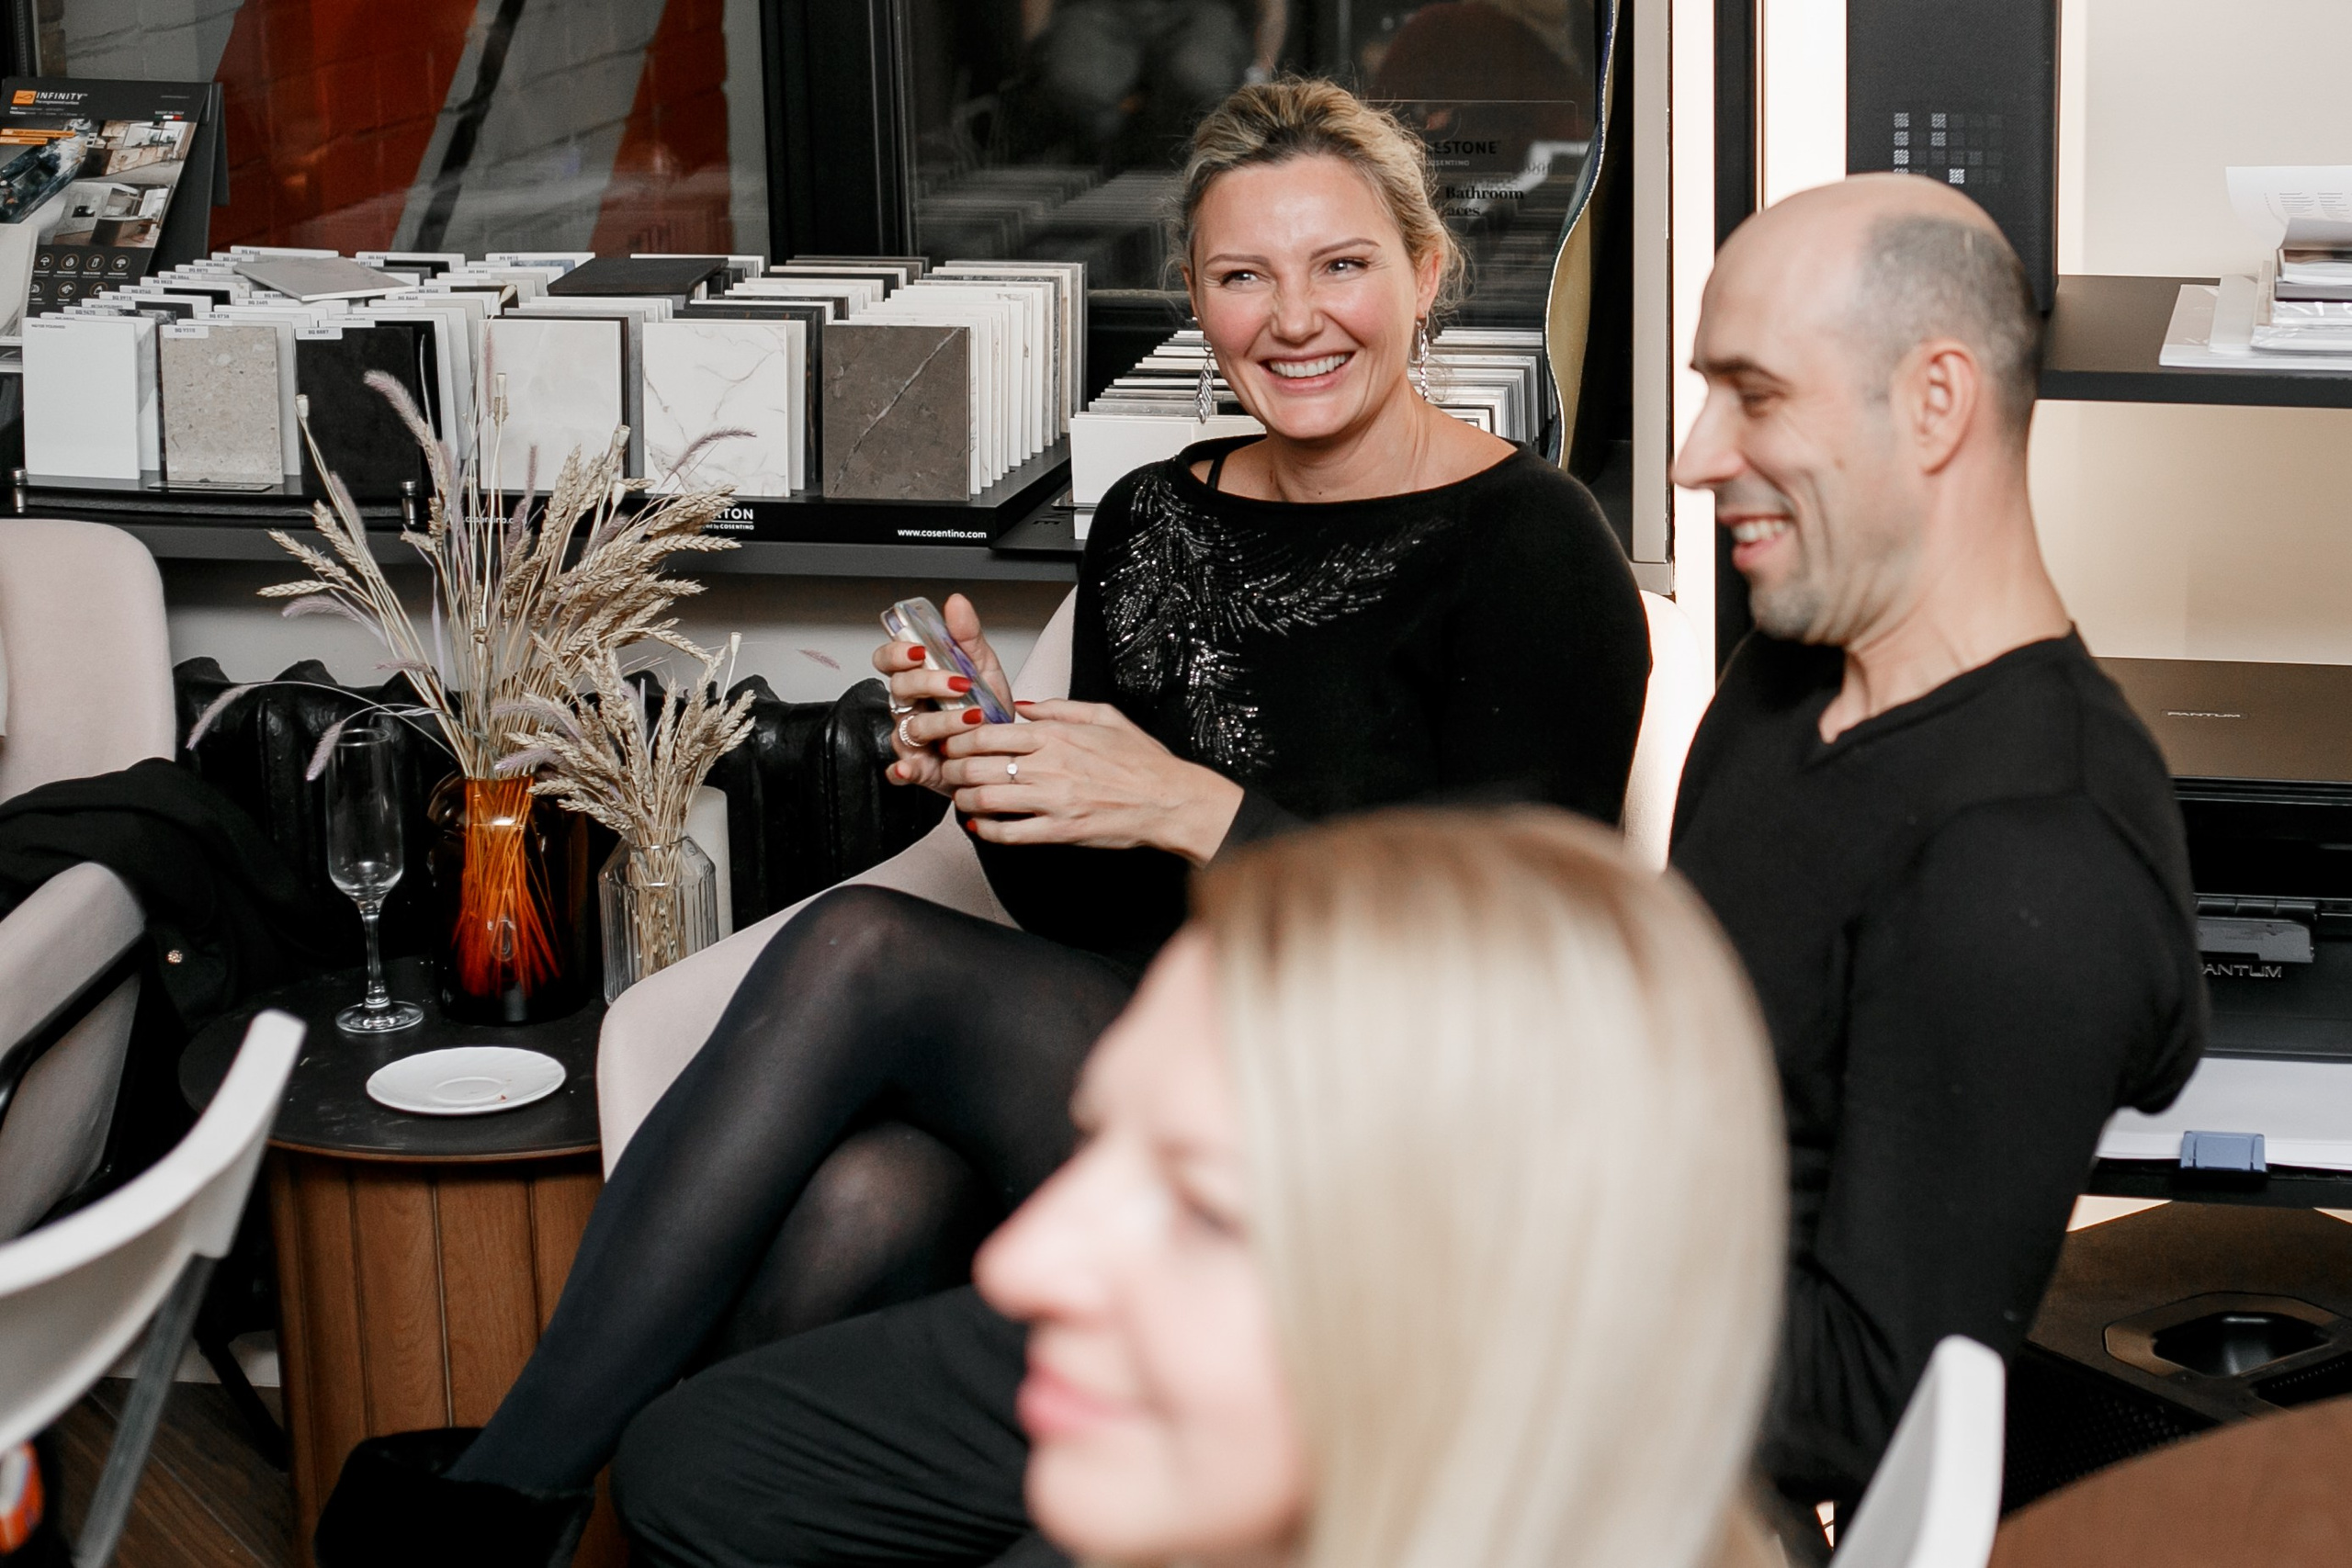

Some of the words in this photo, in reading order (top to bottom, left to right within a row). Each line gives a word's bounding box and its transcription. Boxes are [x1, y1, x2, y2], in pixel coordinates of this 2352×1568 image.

[1445, 186, 1525, 200] Bathroom
[1446, 207, 1481, 217] aces
[897, 528, 988, 539] www.cosentino.com
[2202, 964, 2283, 979] ANTUM
